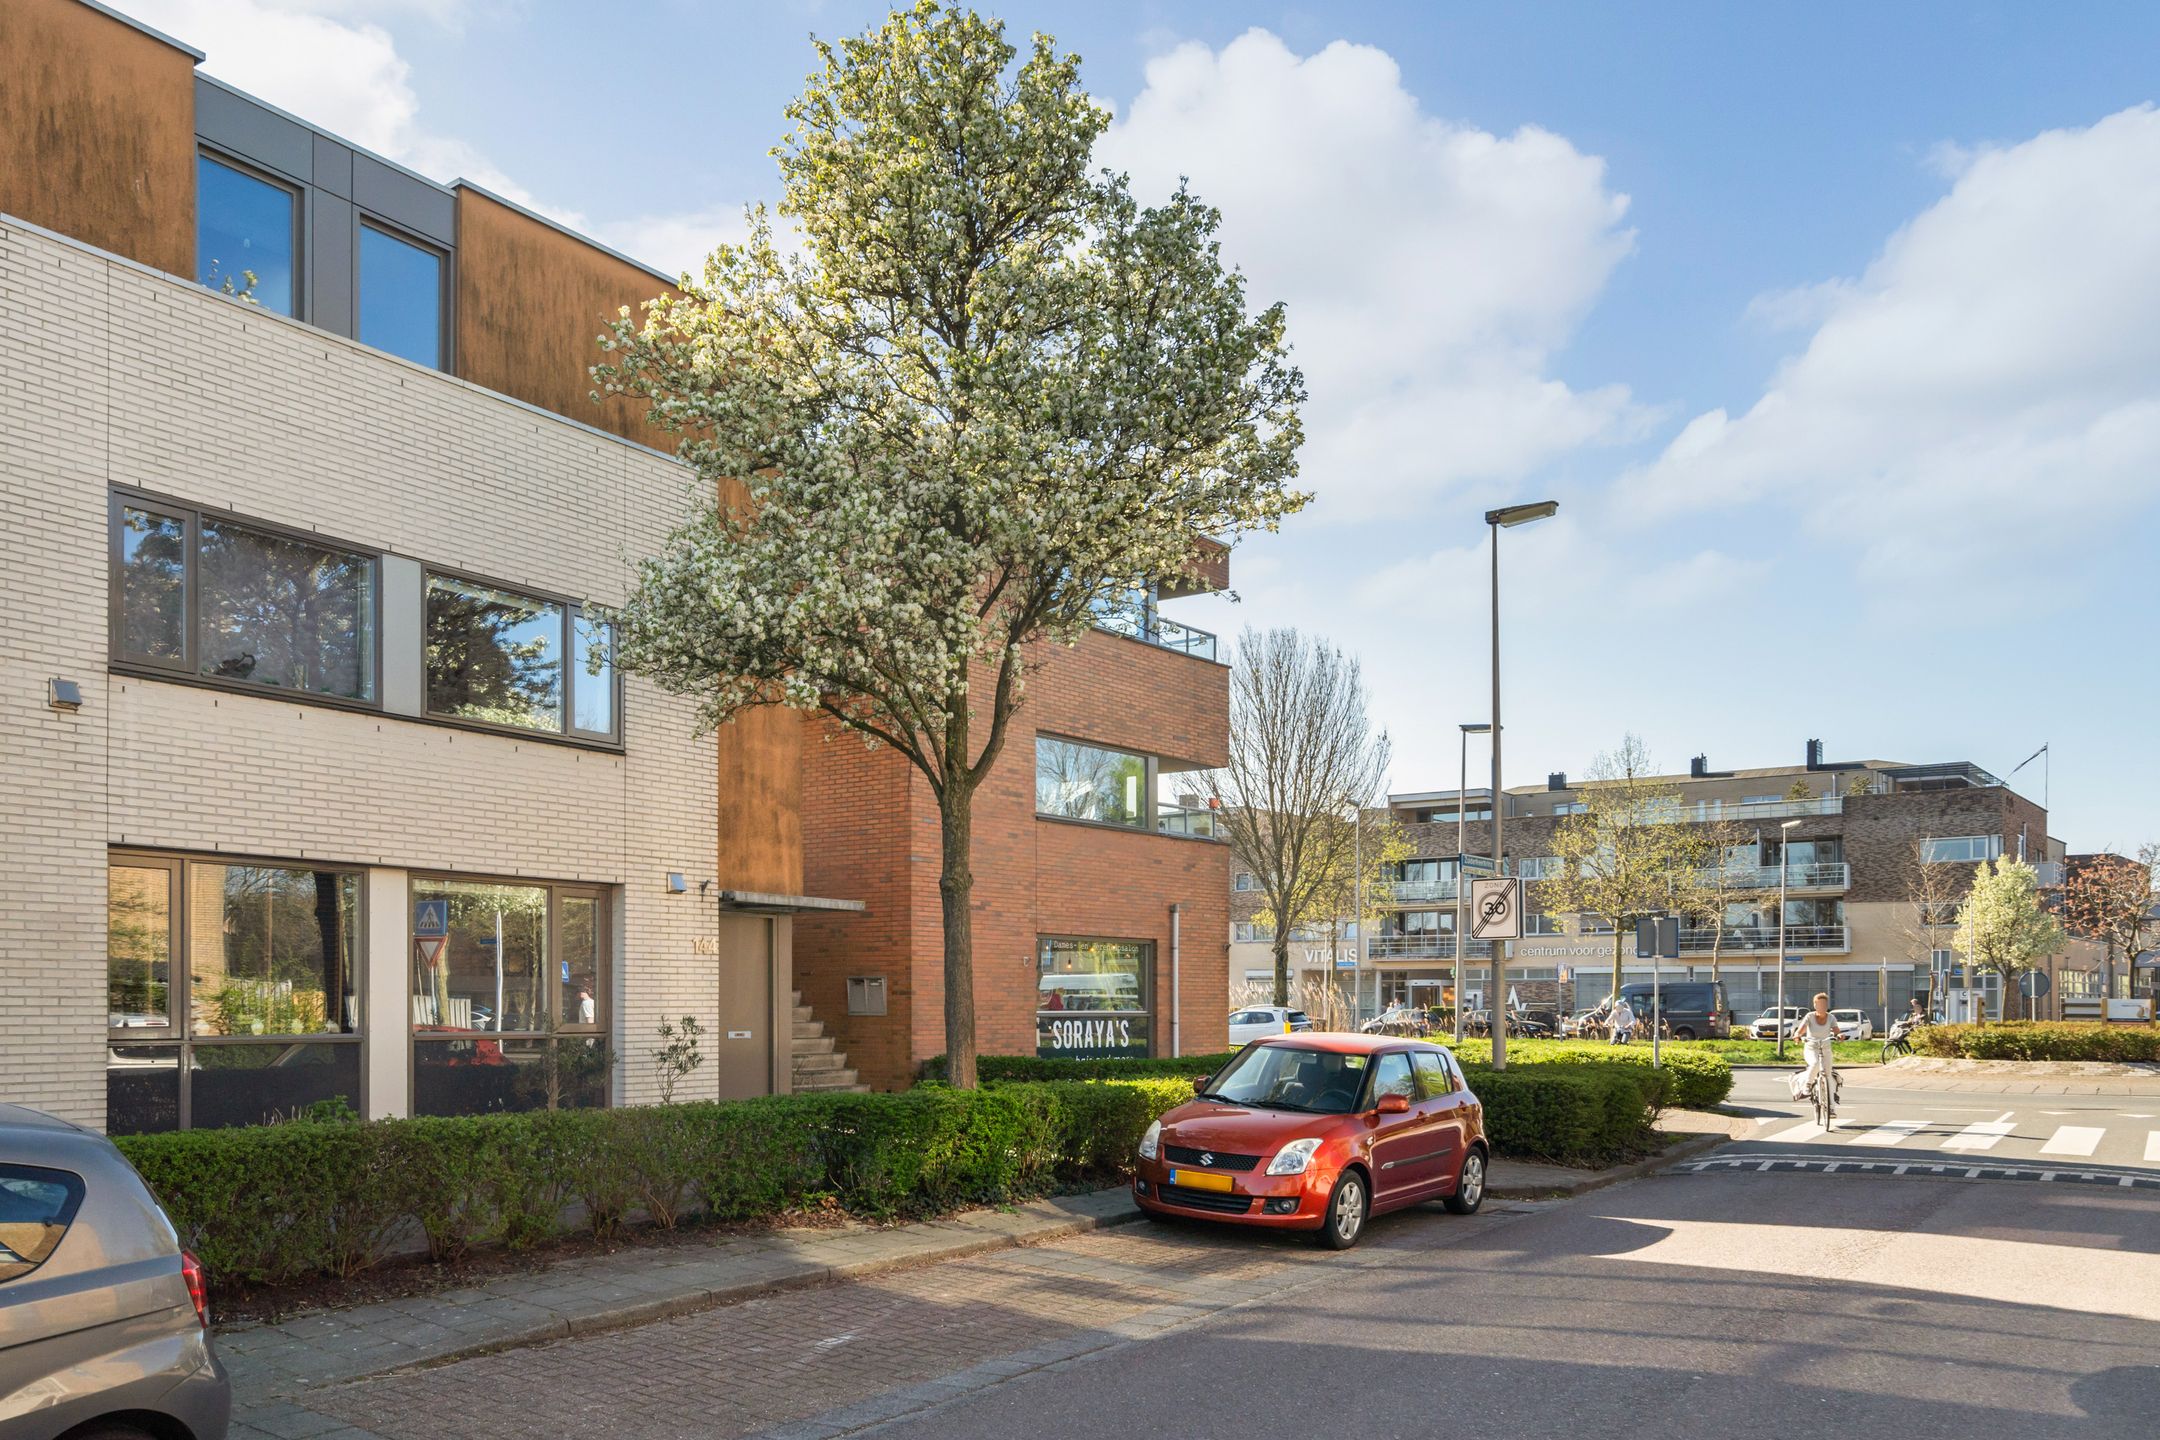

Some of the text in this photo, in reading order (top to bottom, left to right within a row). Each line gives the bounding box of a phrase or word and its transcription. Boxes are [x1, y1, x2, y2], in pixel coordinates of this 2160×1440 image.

[1484, 881, 1504, 889] ZONE
[1484, 902, 1506, 915] 30
[1520, 946, 1567, 957] centrum
[1569, 946, 1596, 956] voor
[1053, 1020, 1129, 1049] SORAYA'S
